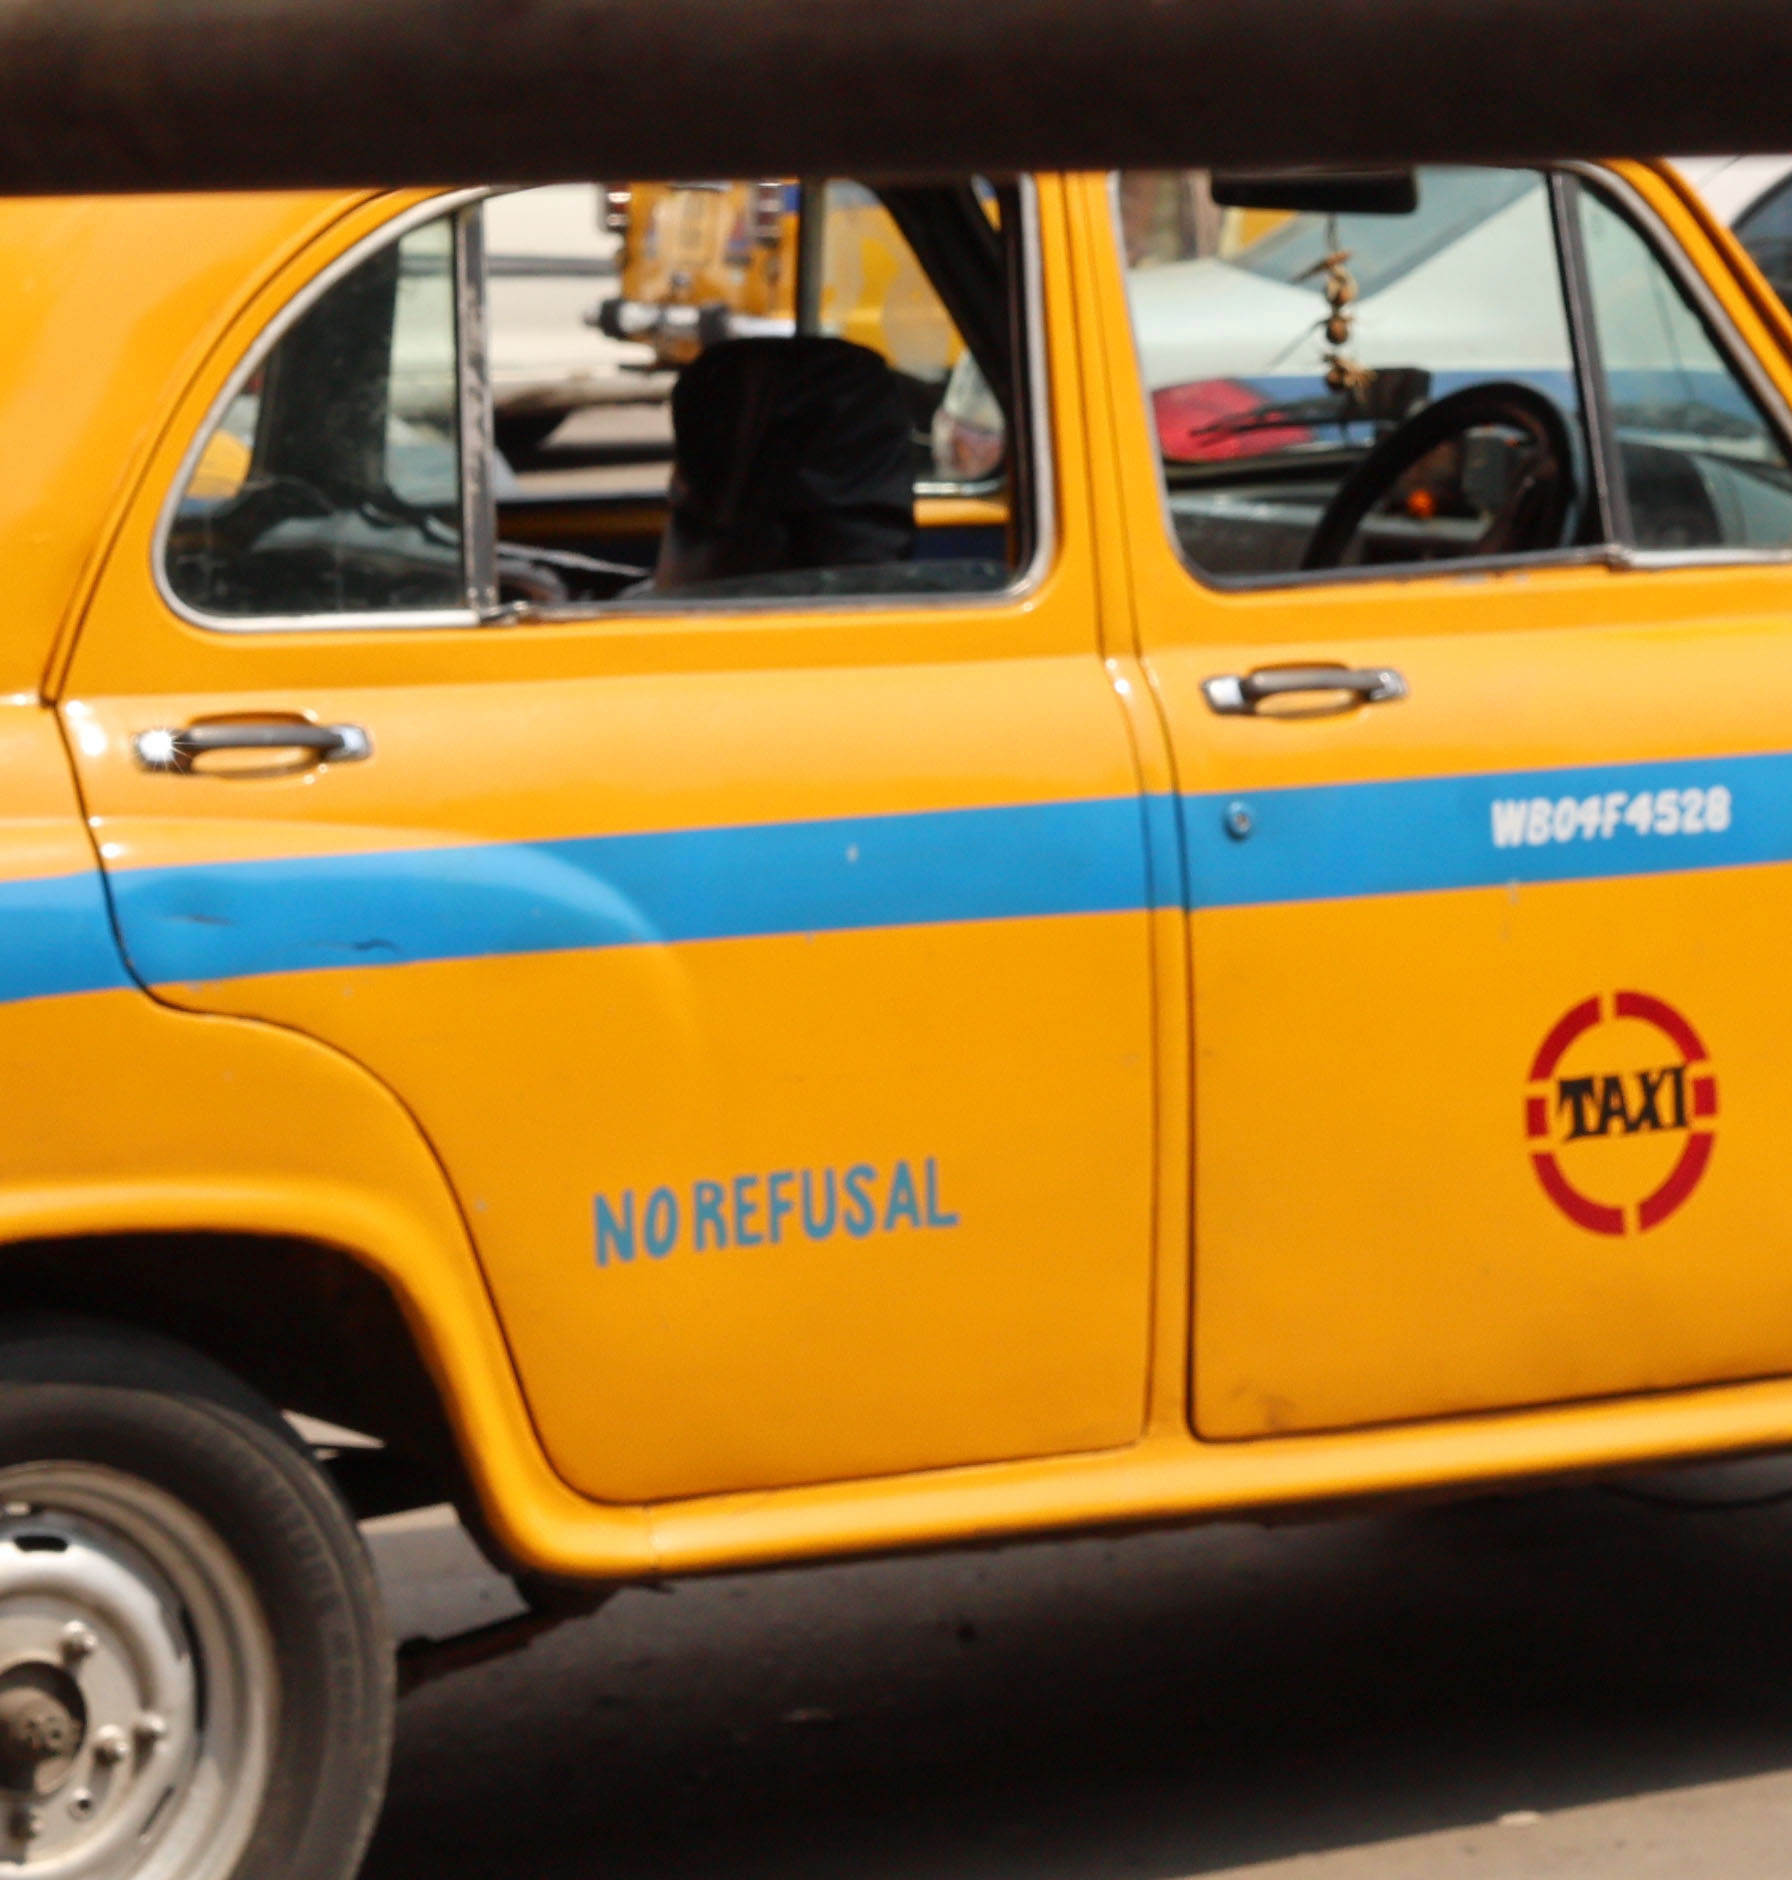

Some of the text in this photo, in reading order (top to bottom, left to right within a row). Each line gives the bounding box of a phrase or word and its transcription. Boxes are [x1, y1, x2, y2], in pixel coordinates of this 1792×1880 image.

[1490, 785, 1732, 848] WB04F4528
[1556, 1064, 1693, 1143] TAXI
[592, 1156, 960, 1268] NO REFUSAL
